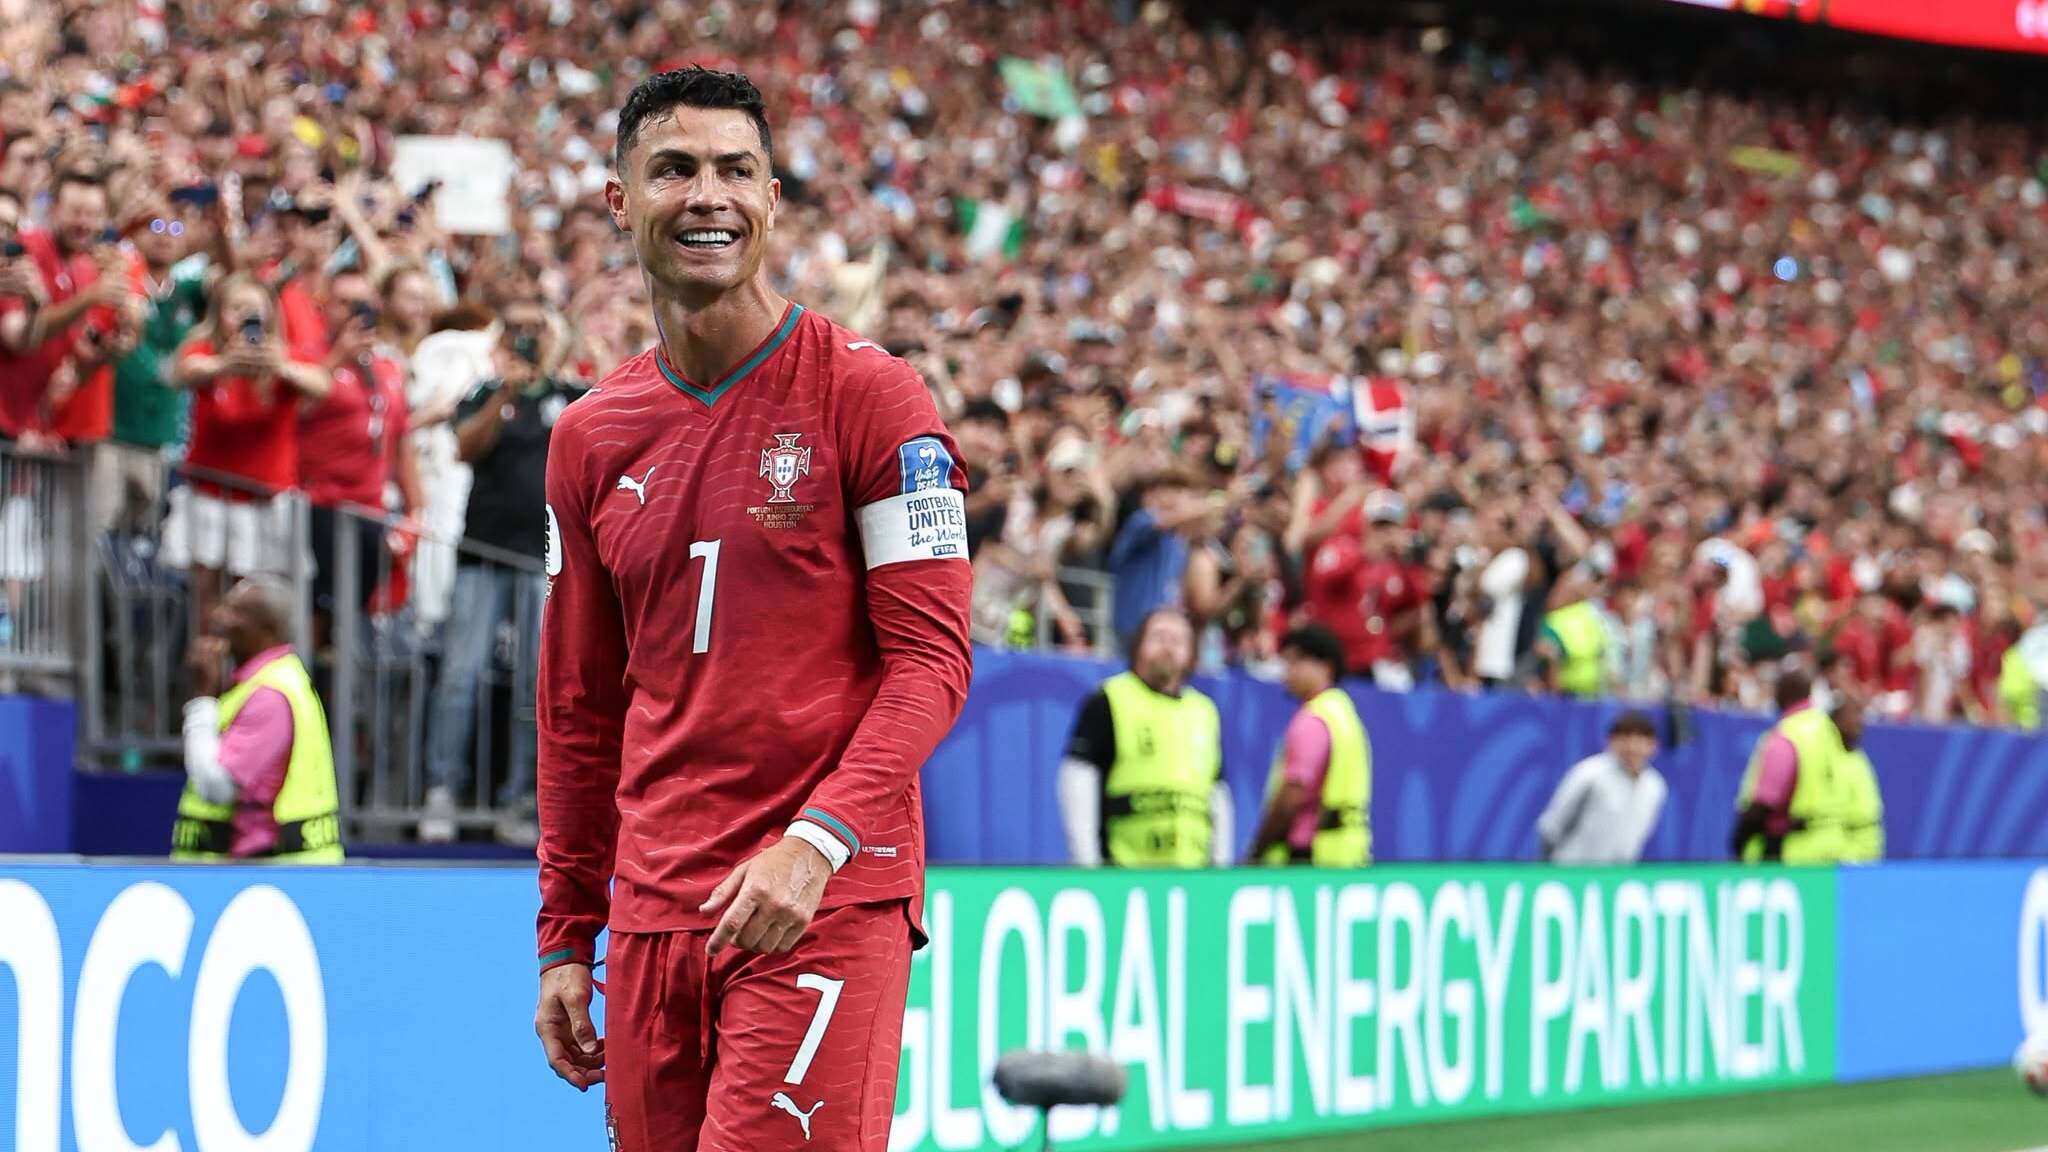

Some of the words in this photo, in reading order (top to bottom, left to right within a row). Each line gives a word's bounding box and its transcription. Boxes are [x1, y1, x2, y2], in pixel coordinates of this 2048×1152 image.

[907, 496, 960, 513] FOOTBALL
[908, 510, 963, 531] UNITES
[907, 531, 934, 547] the
[933, 545, 957, 555] FIFA
[1227, 880, 1525, 1126] ENERGY
[1530, 877, 1805, 1098] PARTNER
[783, 973, 845, 1085] 7
